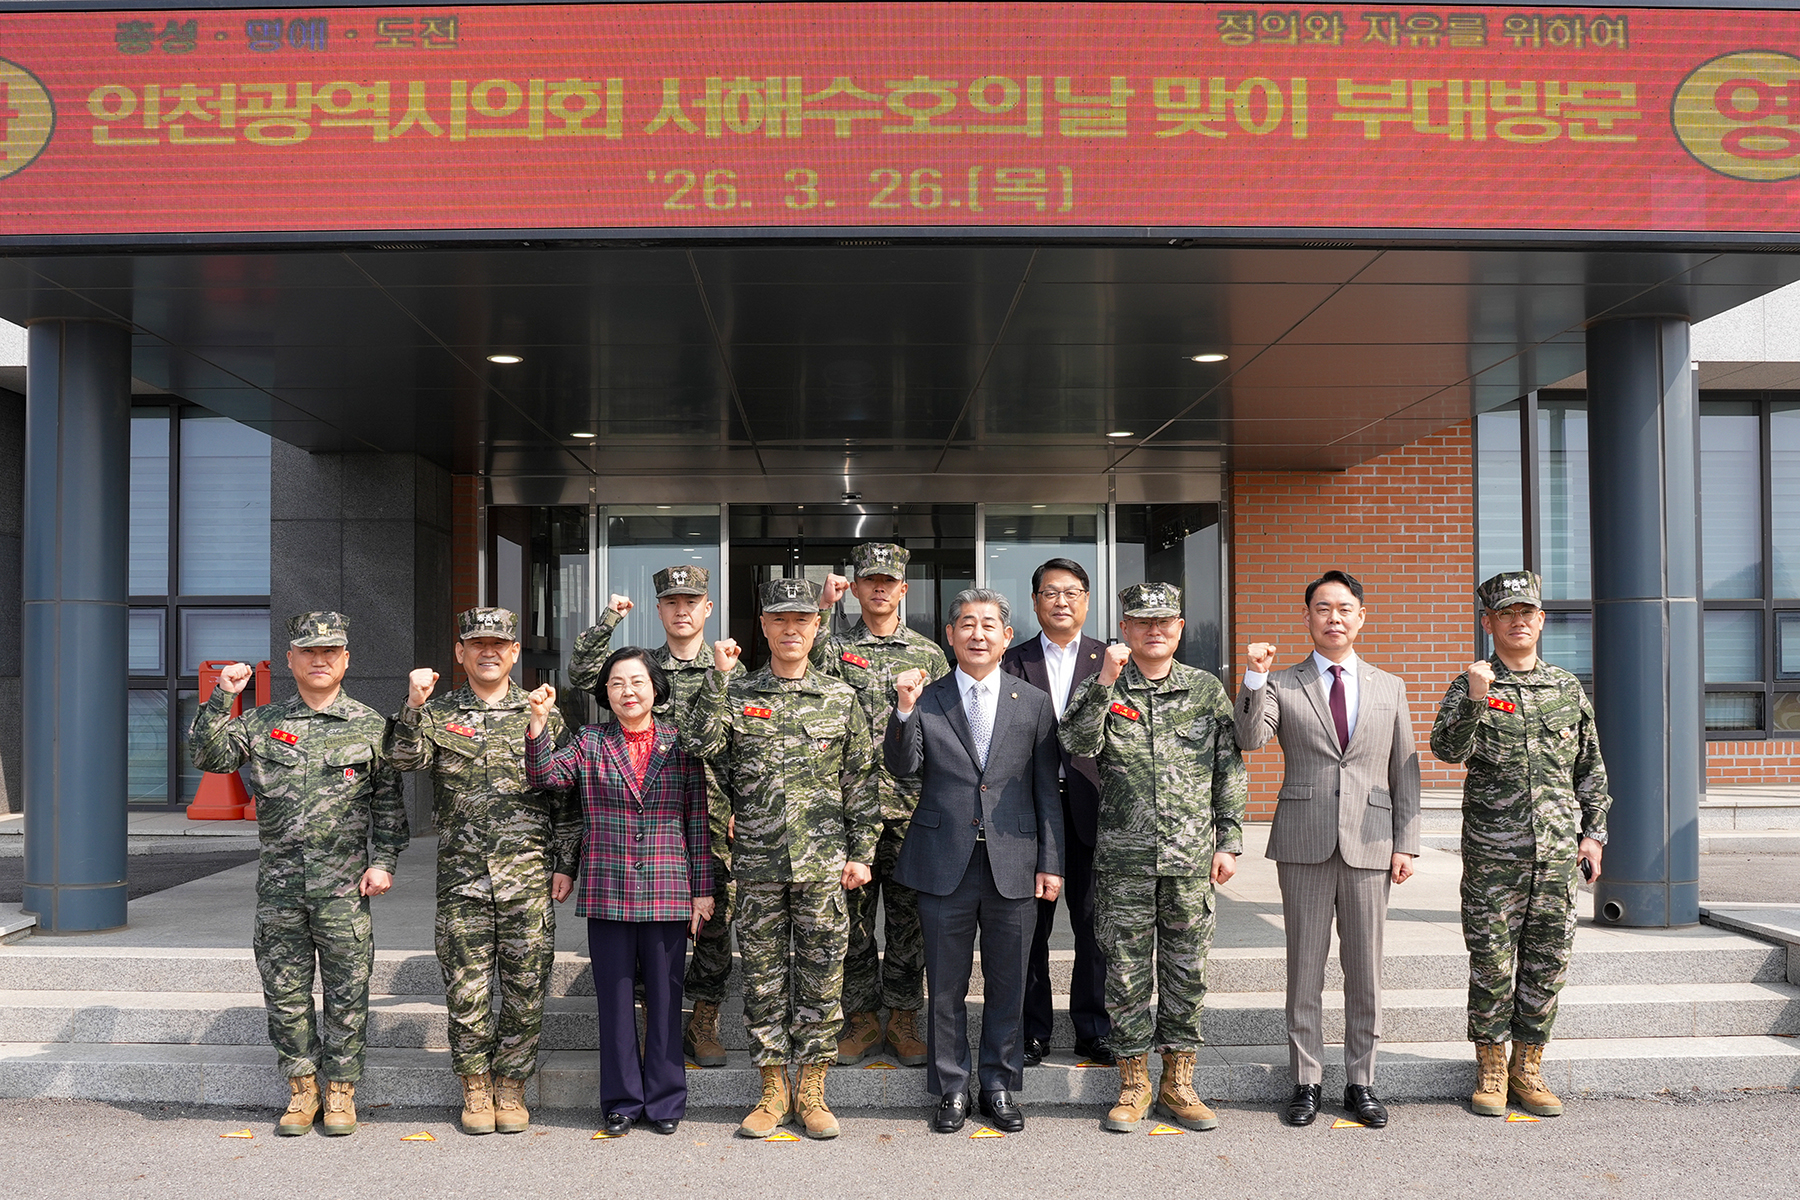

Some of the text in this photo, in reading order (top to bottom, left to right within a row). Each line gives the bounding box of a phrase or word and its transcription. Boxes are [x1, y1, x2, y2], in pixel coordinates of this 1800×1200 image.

[114, 19, 199, 55] 충성
[245, 16, 328, 52] 명예
[374, 15, 459, 50] 도전
[1216, 10, 1630, 50] 정의와 자유를 위하여
[85, 77, 623, 147] 인천광역시의회
[642, 75, 1136, 139] 서해수호의날
[1152, 76, 1308, 140] 맞이
[1330, 79, 1643, 144] 부대방문
[783, 168, 836, 211] 3.
